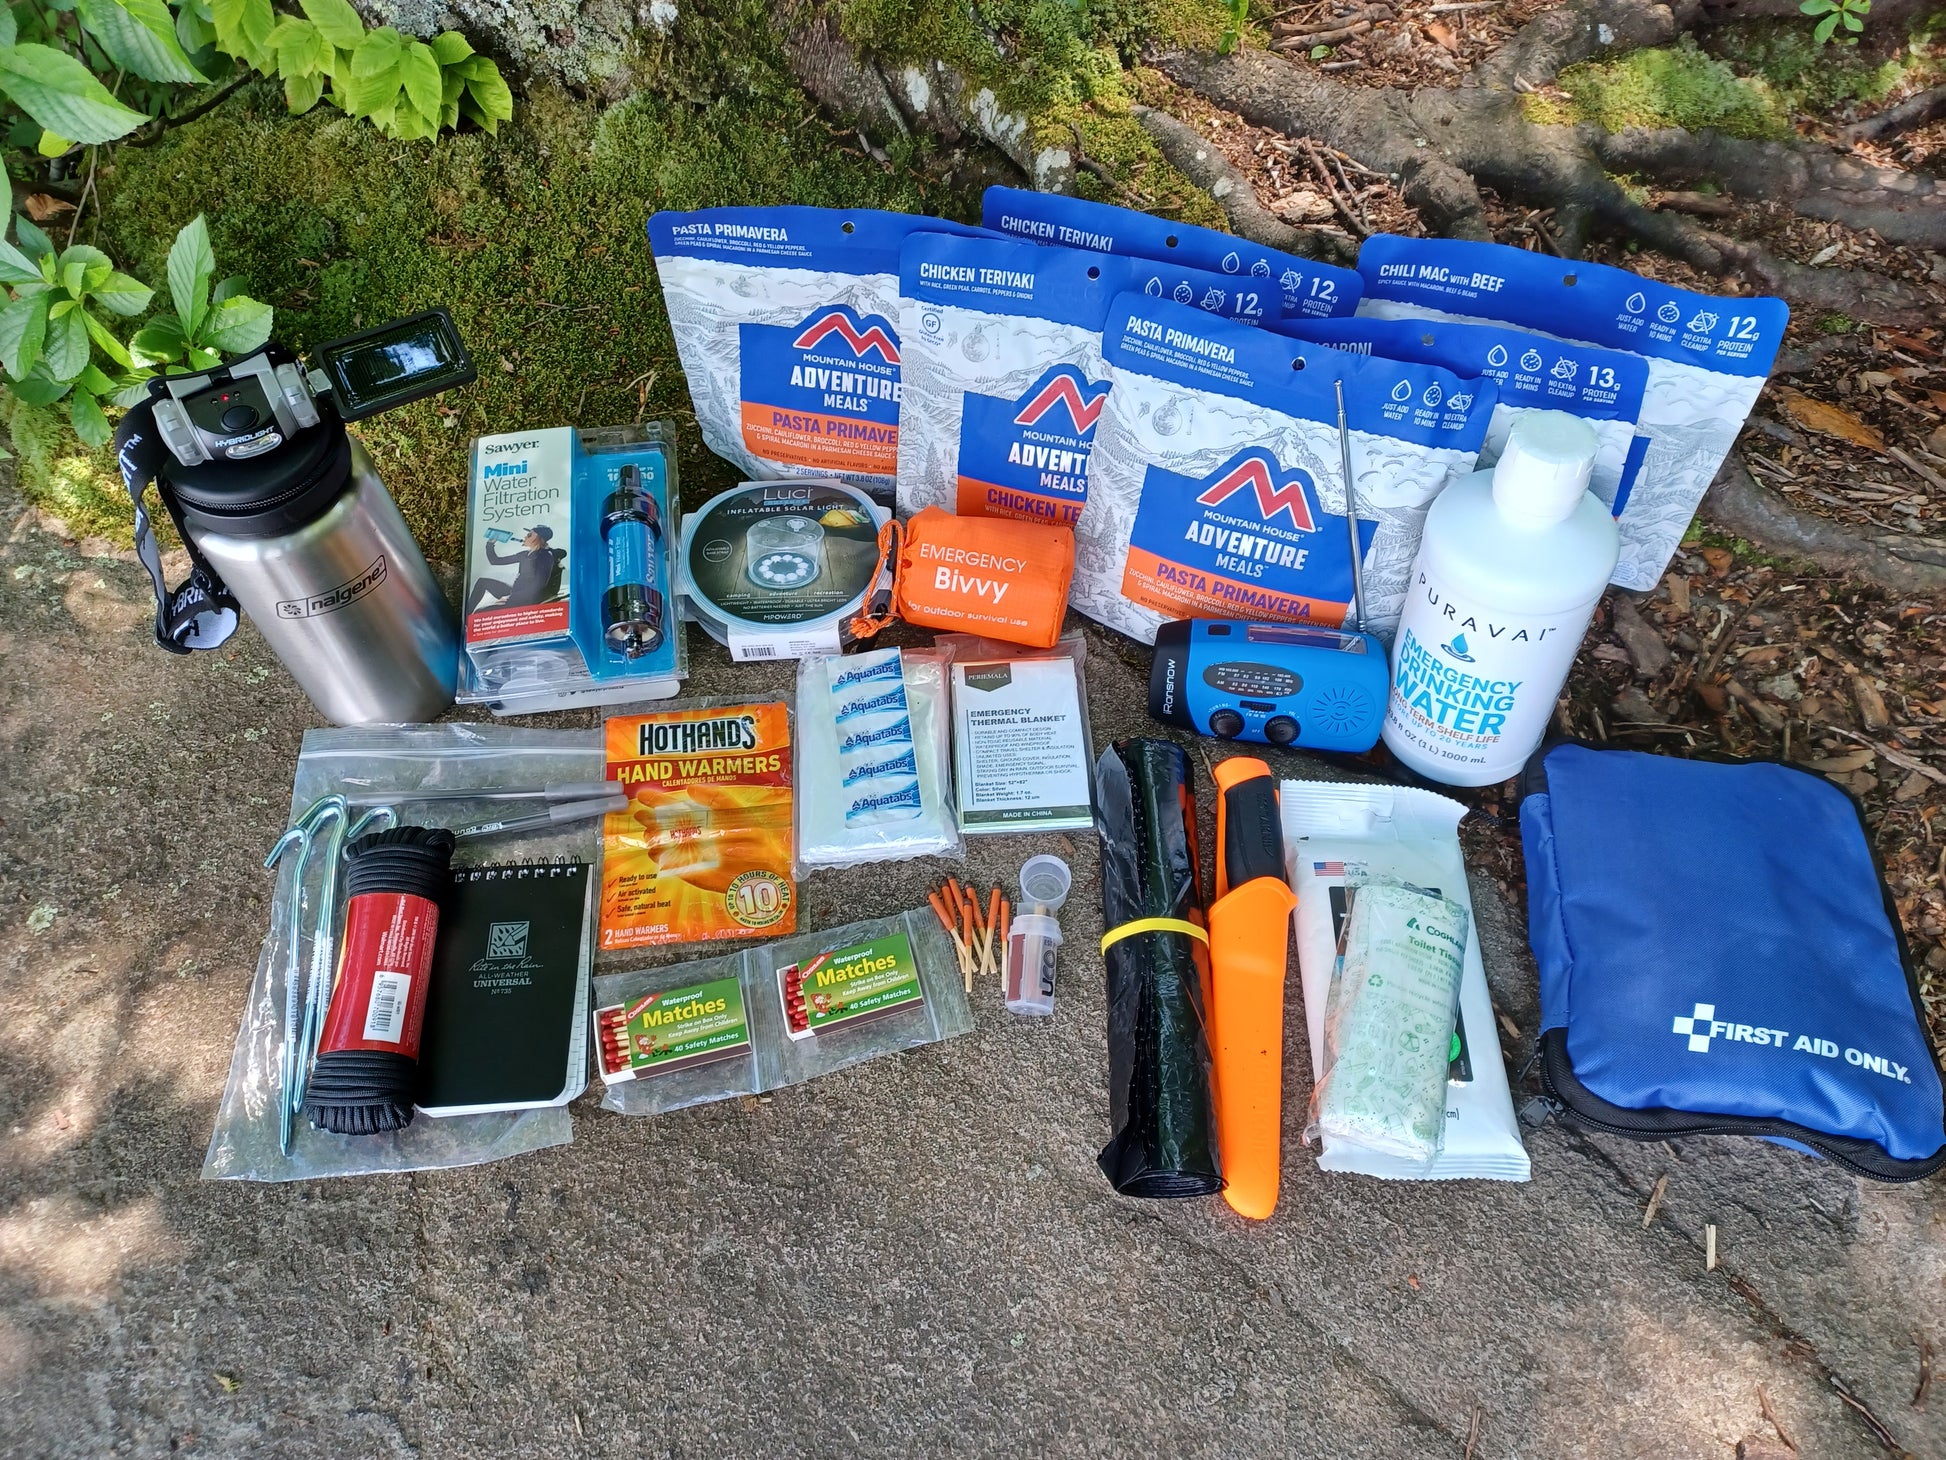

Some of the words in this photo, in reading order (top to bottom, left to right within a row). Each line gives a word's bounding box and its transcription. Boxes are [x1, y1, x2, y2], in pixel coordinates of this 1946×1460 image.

[672, 223, 712, 236] PASTA
[714, 223, 788, 242] PRIMAVERA
[1001, 214, 1054, 238] CHICKEN
[1059, 226, 1113, 252] TERIYAKI
[920, 262, 975, 282] CHICKEN
[979, 268, 1035, 290] TERIYAKI
[1379, 264, 1416, 278] CHILI
[1418, 265, 1450, 282] MAC
[1450, 274, 1470, 286] WITH
[1470, 272, 1506, 293] BEEF
[921, 305, 944, 314] Certified
[1302, 298, 1333, 314] PROTEIN
[925, 319, 936, 328] GF
[1616, 313, 1630, 324] JUST
[1630, 317, 1644, 327] ADD
[1618, 322, 1638, 333] WATER
[1650, 322, 1669, 334] READY
[1670, 328, 1676, 336] IN
[1126, 316, 1163, 342] PASTA
[1164, 328, 1235, 364] PRIMAVERA
[1649, 330, 1656, 338] 10
[1656, 332, 1672, 342] MINS
[1682, 332, 1692, 341] NO
[1692, 334, 1712, 345] EXTRA
[1680, 340, 1709, 352] CLEANUP
[1717, 340, 1754, 354] PROTEIN
[803, 354, 856, 368] MOUNTAIN
[824, 393, 868, 412] MEALS
[1582, 388, 1618, 400] PROTEIN
[772, 412, 820, 434] PASTA
[215, 426, 274, 448] HYBRIDLIGHT
[746, 422, 773, 435] ZUCCHINI,
[774, 428, 812, 442] CAULIFLOWER,
[814, 436, 842, 447] BROCCOLI,
[844, 440, 854, 448] RED
[860, 442, 881, 451] YELLOW
[1022, 430, 1077, 447] MOUNTAIN
[485, 440, 539, 455] Sawyer
[484, 460, 528, 479] Mini
[484, 476, 537, 493] Water
[1040, 472, 1085, 493] MEALS
[484, 487, 560, 507] Filtration
[764, 486, 811, 500] Luci
[727, 506, 781, 515] INFLATABLE
[784, 504, 814, 512] SOLAR
[987, 488, 1057, 518] CHICKEN
[482, 503, 550, 523] System
[1204, 510, 1260, 532] MOUNTAIN
[1184, 520, 1309, 570] ADVENTURE
[920, 542, 1027, 574] EMERGENCY
[1215, 553, 1264, 578] MEALS
[311, 568, 380, 611] nalgene
[934, 566, 1010, 604] Bivvy
[1156, 562, 1207, 592] PASTA
[1211, 580, 1311, 618] PRIMAVERA
[924, 606, 965, 618] outdoor
[968, 612, 1008, 624] survival
[1010, 618, 1028, 627] use
[1418, 572, 1546, 642] PURAVAI
[1404, 627, 1524, 695] EMERGENCY
[846, 664, 894, 683] Aquatabs
[1400, 642, 1516, 712] DRINKING
[850, 694, 898, 714] Aquatabs
[1396, 657, 1506, 736] WATER
[970, 708, 1031, 718] EMERGENCY
[970, 716, 1018, 726] THERMAL
[1020, 714, 1066, 724] BLANKET
[1390, 680, 1408, 710] LONG
[1409, 706, 1435, 730] TERM
[1436, 723, 1474, 742] SHELF
[1475, 734, 1501, 744] LIFE
[640, 716, 756, 756] HOTHANDS
[855, 726, 903, 746] Aquatabs
[1441, 750, 1468, 763] 1000
[1470, 756, 1486, 764] mL
[617, 762, 673, 784] HAND
[678, 754, 782, 777] WARMERS
[858, 759, 908, 778] Aquatabs
[662, 776, 706, 788] CALENTADORES
[706, 776, 716, 784] DE
[716, 774, 737, 782] MANOS
[862, 792, 912, 810] Aquatabs
[618, 874, 638, 883] Ready
[738, 870, 767, 883] HOURS
[768, 873, 778, 881] OF
[778, 881, 790, 902] HEAT
[628, 886, 656, 896] activated
[740, 882, 779, 915] 10
[617, 904, 632, 913] Safe,
[634, 900, 656, 910] natural
[656, 900, 671, 908] heat
[604, 928, 613, 944] 2
[614, 928, 634, 938] HAND
[634, 924, 669, 935] WARMERS
[1409, 936, 1436, 953] Toilet
[500, 962, 516, 970] the
[833, 948, 873, 966] Waterproof
[478, 971, 529, 979] ALL-WEATHER
[816, 955, 896, 988] Matches
[850, 980, 866, 988] Strike
[874, 974, 885, 982] Box
[885, 970, 898, 978] Only
[473, 978, 532, 988] UNIVERSAL
[661, 990, 703, 1006] Waterproof
[850, 1002, 858, 1010] 40
[860, 996, 882, 1008] Safety
[882, 988, 912, 1001] Matches
[642, 998, 726, 1029] Matches
[676, 1022, 694, 1030] Strike
[714, 1014, 728, 1022] Only
[684, 1040, 708, 1050] Safety
[709, 1032, 739, 1044] Matches
[1710, 1020, 1790, 1048] FIRST
[1792, 1034, 1840, 1058] AID
